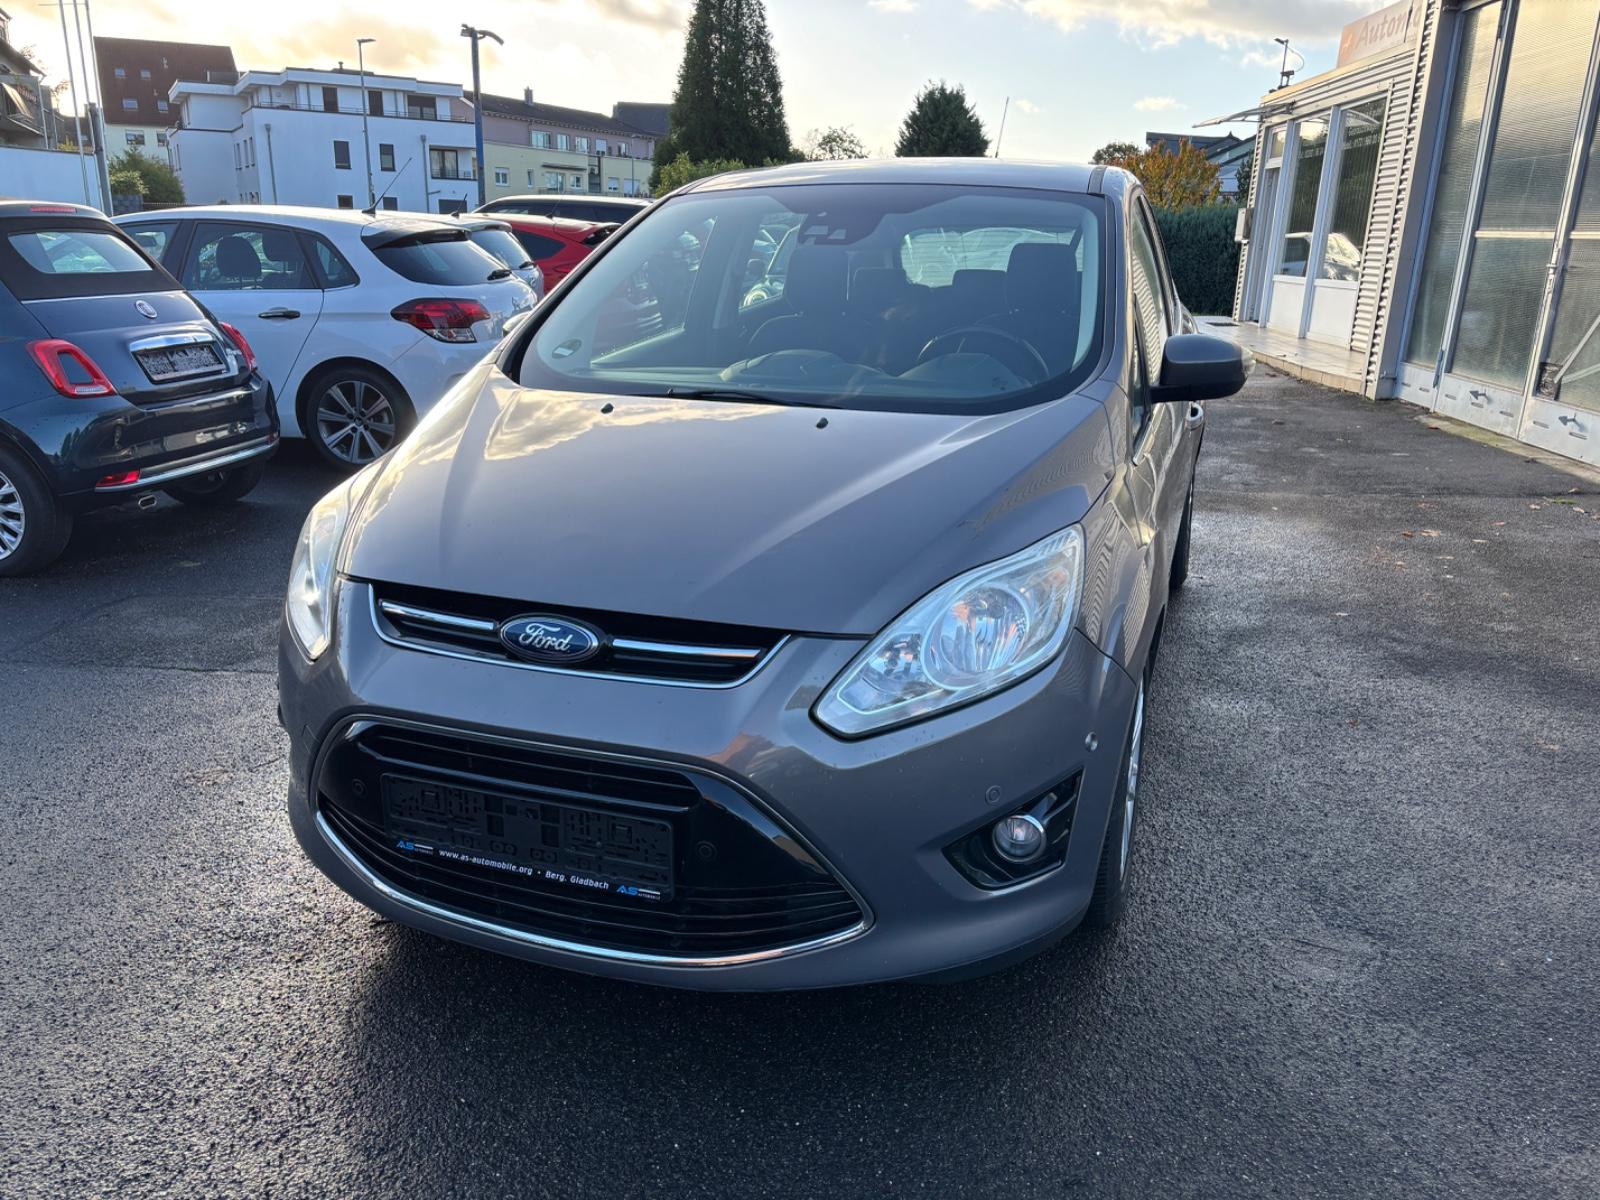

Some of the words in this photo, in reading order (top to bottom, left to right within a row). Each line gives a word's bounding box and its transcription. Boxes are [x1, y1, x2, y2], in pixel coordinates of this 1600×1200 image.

[519, 623, 573, 651] Ford
[396, 840, 415, 851] AS
[438, 849, 533, 876] www.as-automobile.org
[545, 870, 567, 882] Berg.
[570, 875, 609, 889] Gladbach
[616, 885, 639, 896] AS
